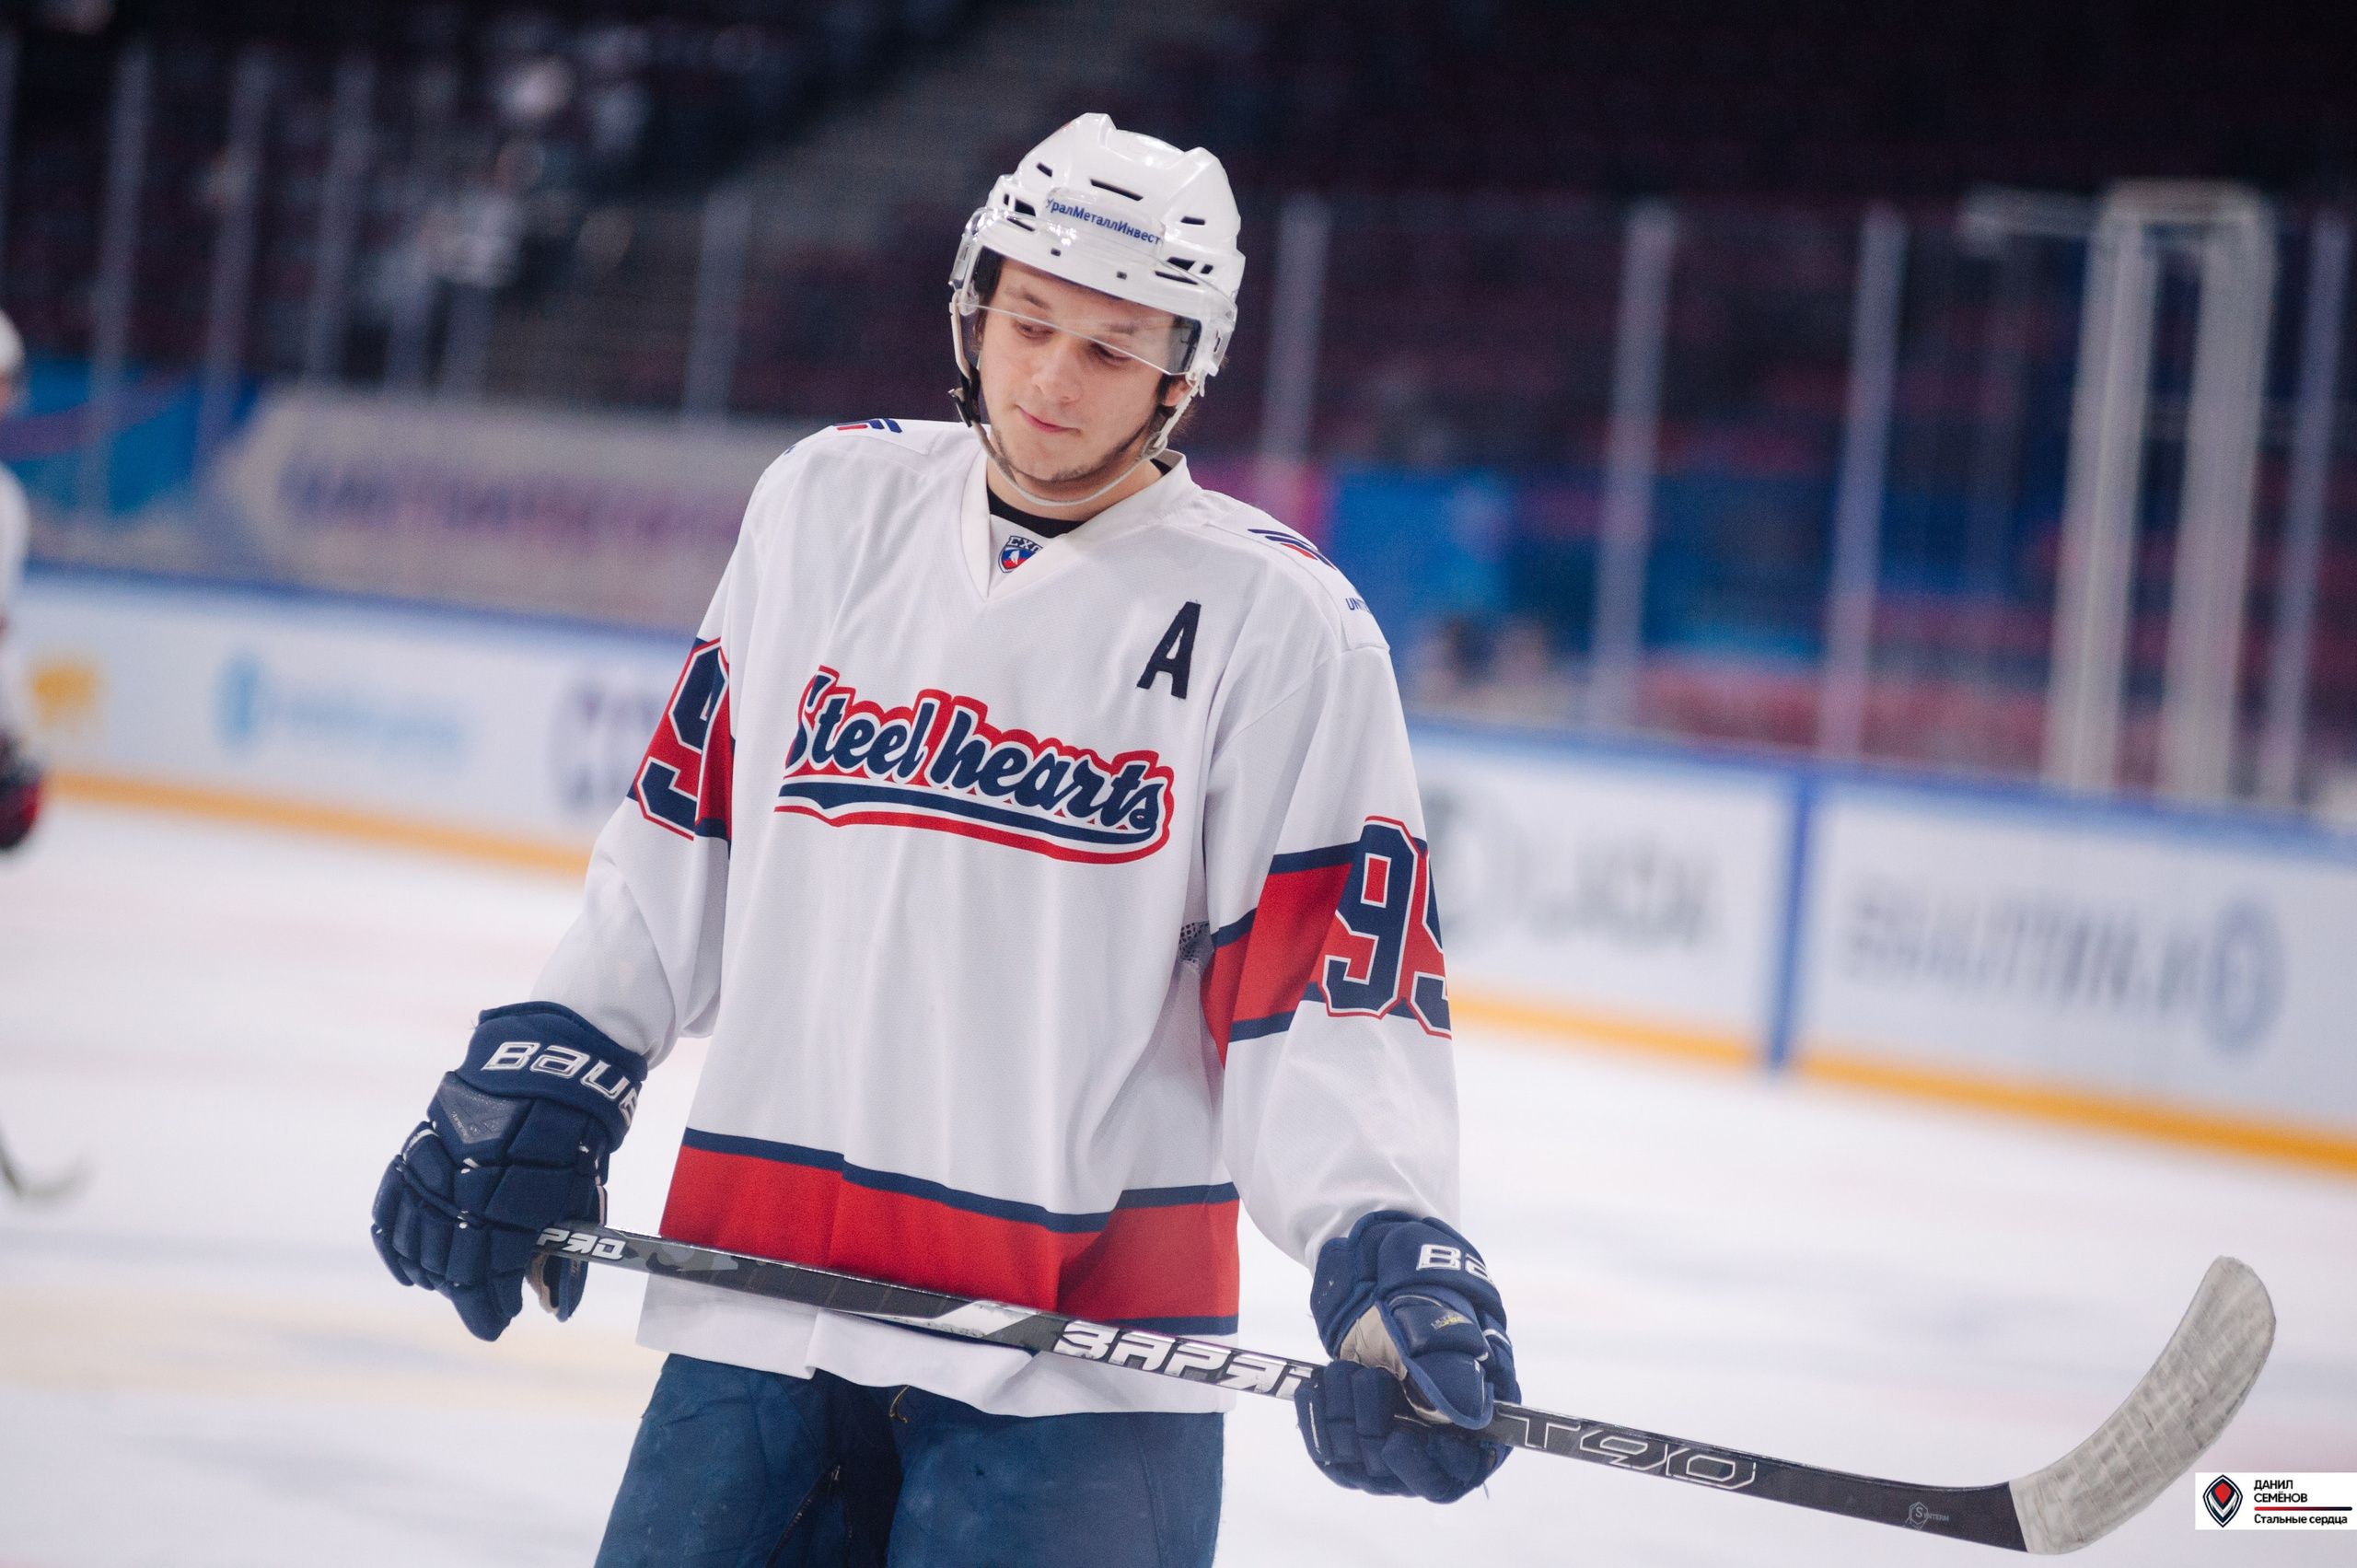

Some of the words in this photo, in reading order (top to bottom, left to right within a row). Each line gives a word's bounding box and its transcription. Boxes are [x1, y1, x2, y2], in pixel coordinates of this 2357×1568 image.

[1046, 198, 1161, 246] УралМеталлИнвест
[1136, 600, 1202, 700] A
[928, 705, 1167, 831] hearts
